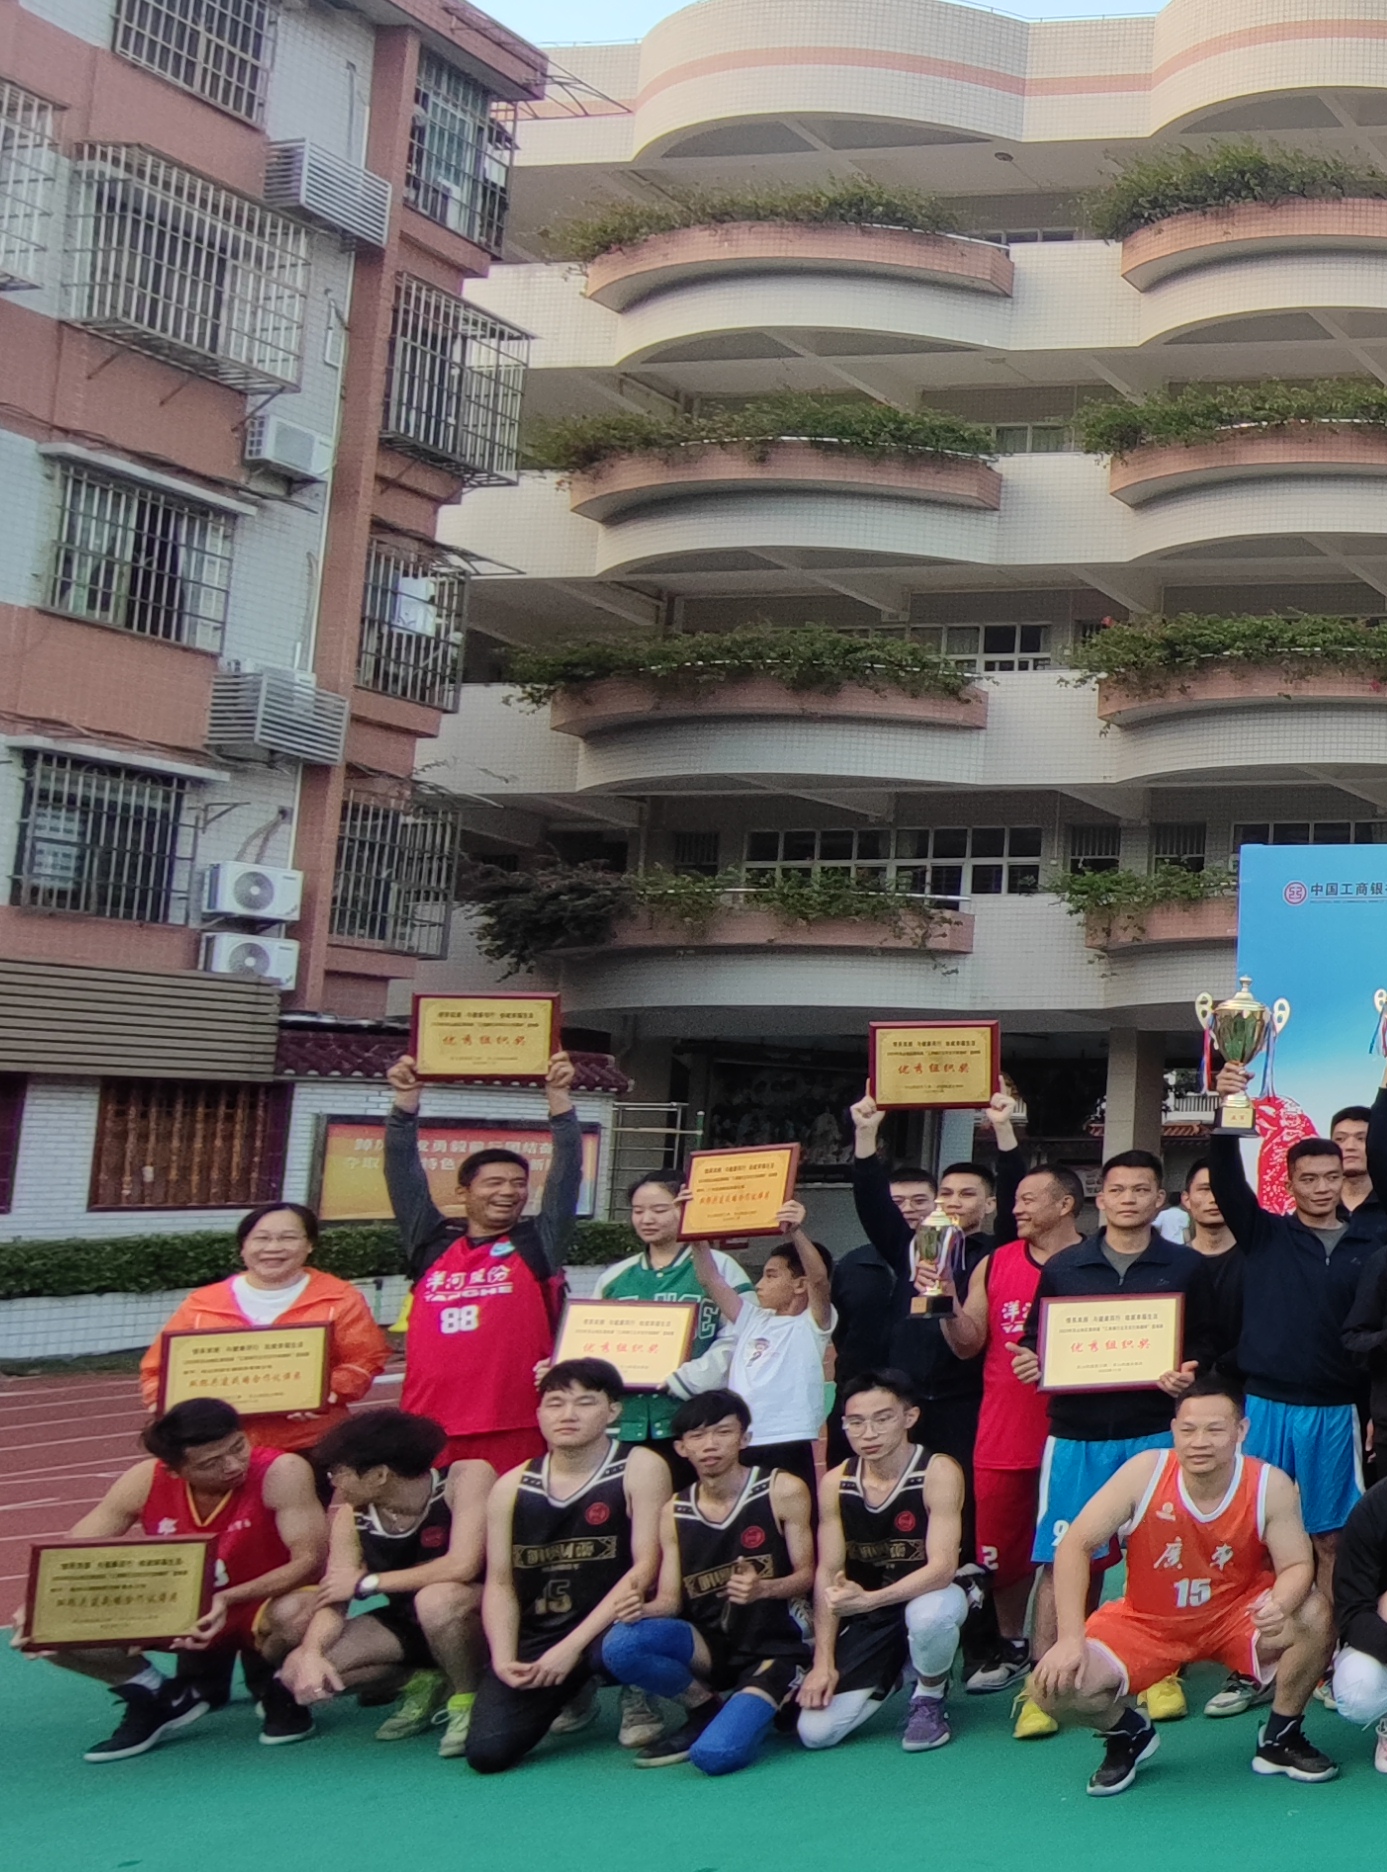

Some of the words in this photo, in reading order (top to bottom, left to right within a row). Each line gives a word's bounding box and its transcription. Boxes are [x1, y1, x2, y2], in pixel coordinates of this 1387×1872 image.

[440, 1305, 479, 1334] 88
[1070, 1338, 1152, 1353] 优秀组织奖
[1174, 1578, 1211, 1608] 15
